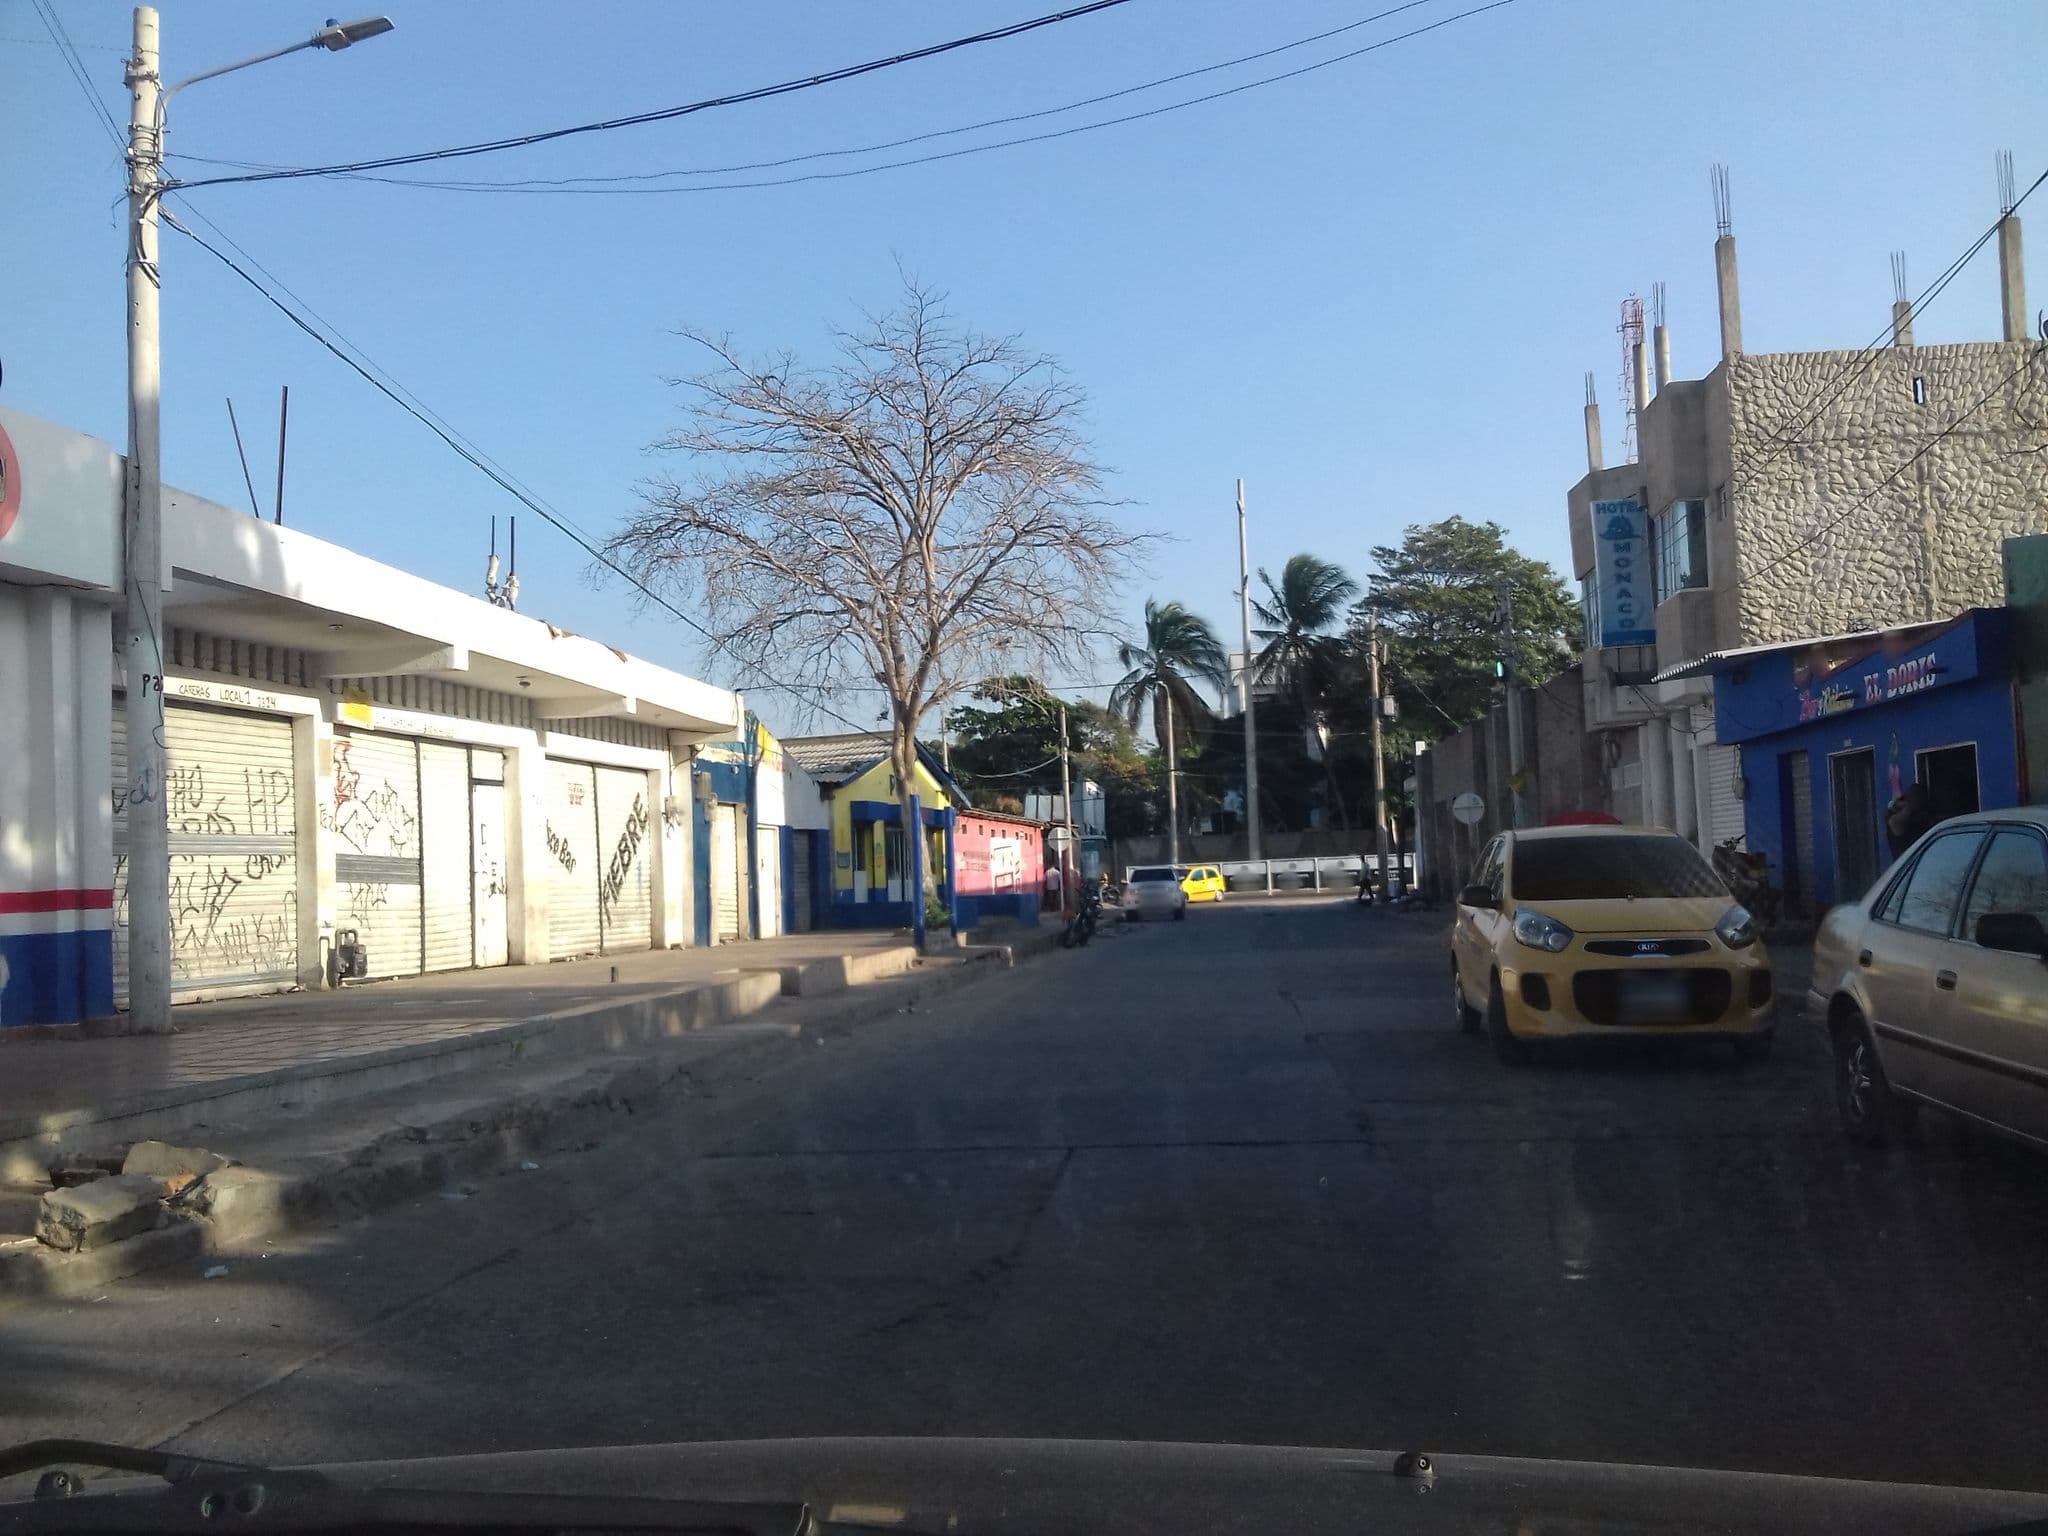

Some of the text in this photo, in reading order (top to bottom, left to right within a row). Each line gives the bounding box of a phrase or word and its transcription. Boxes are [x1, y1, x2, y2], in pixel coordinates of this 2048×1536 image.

[1596, 501, 1644, 514] HOTEL
[1614, 542, 1636, 629] MONACO
[559, 837, 577, 874] Bar
[602, 792, 648, 929] FIEBRE
